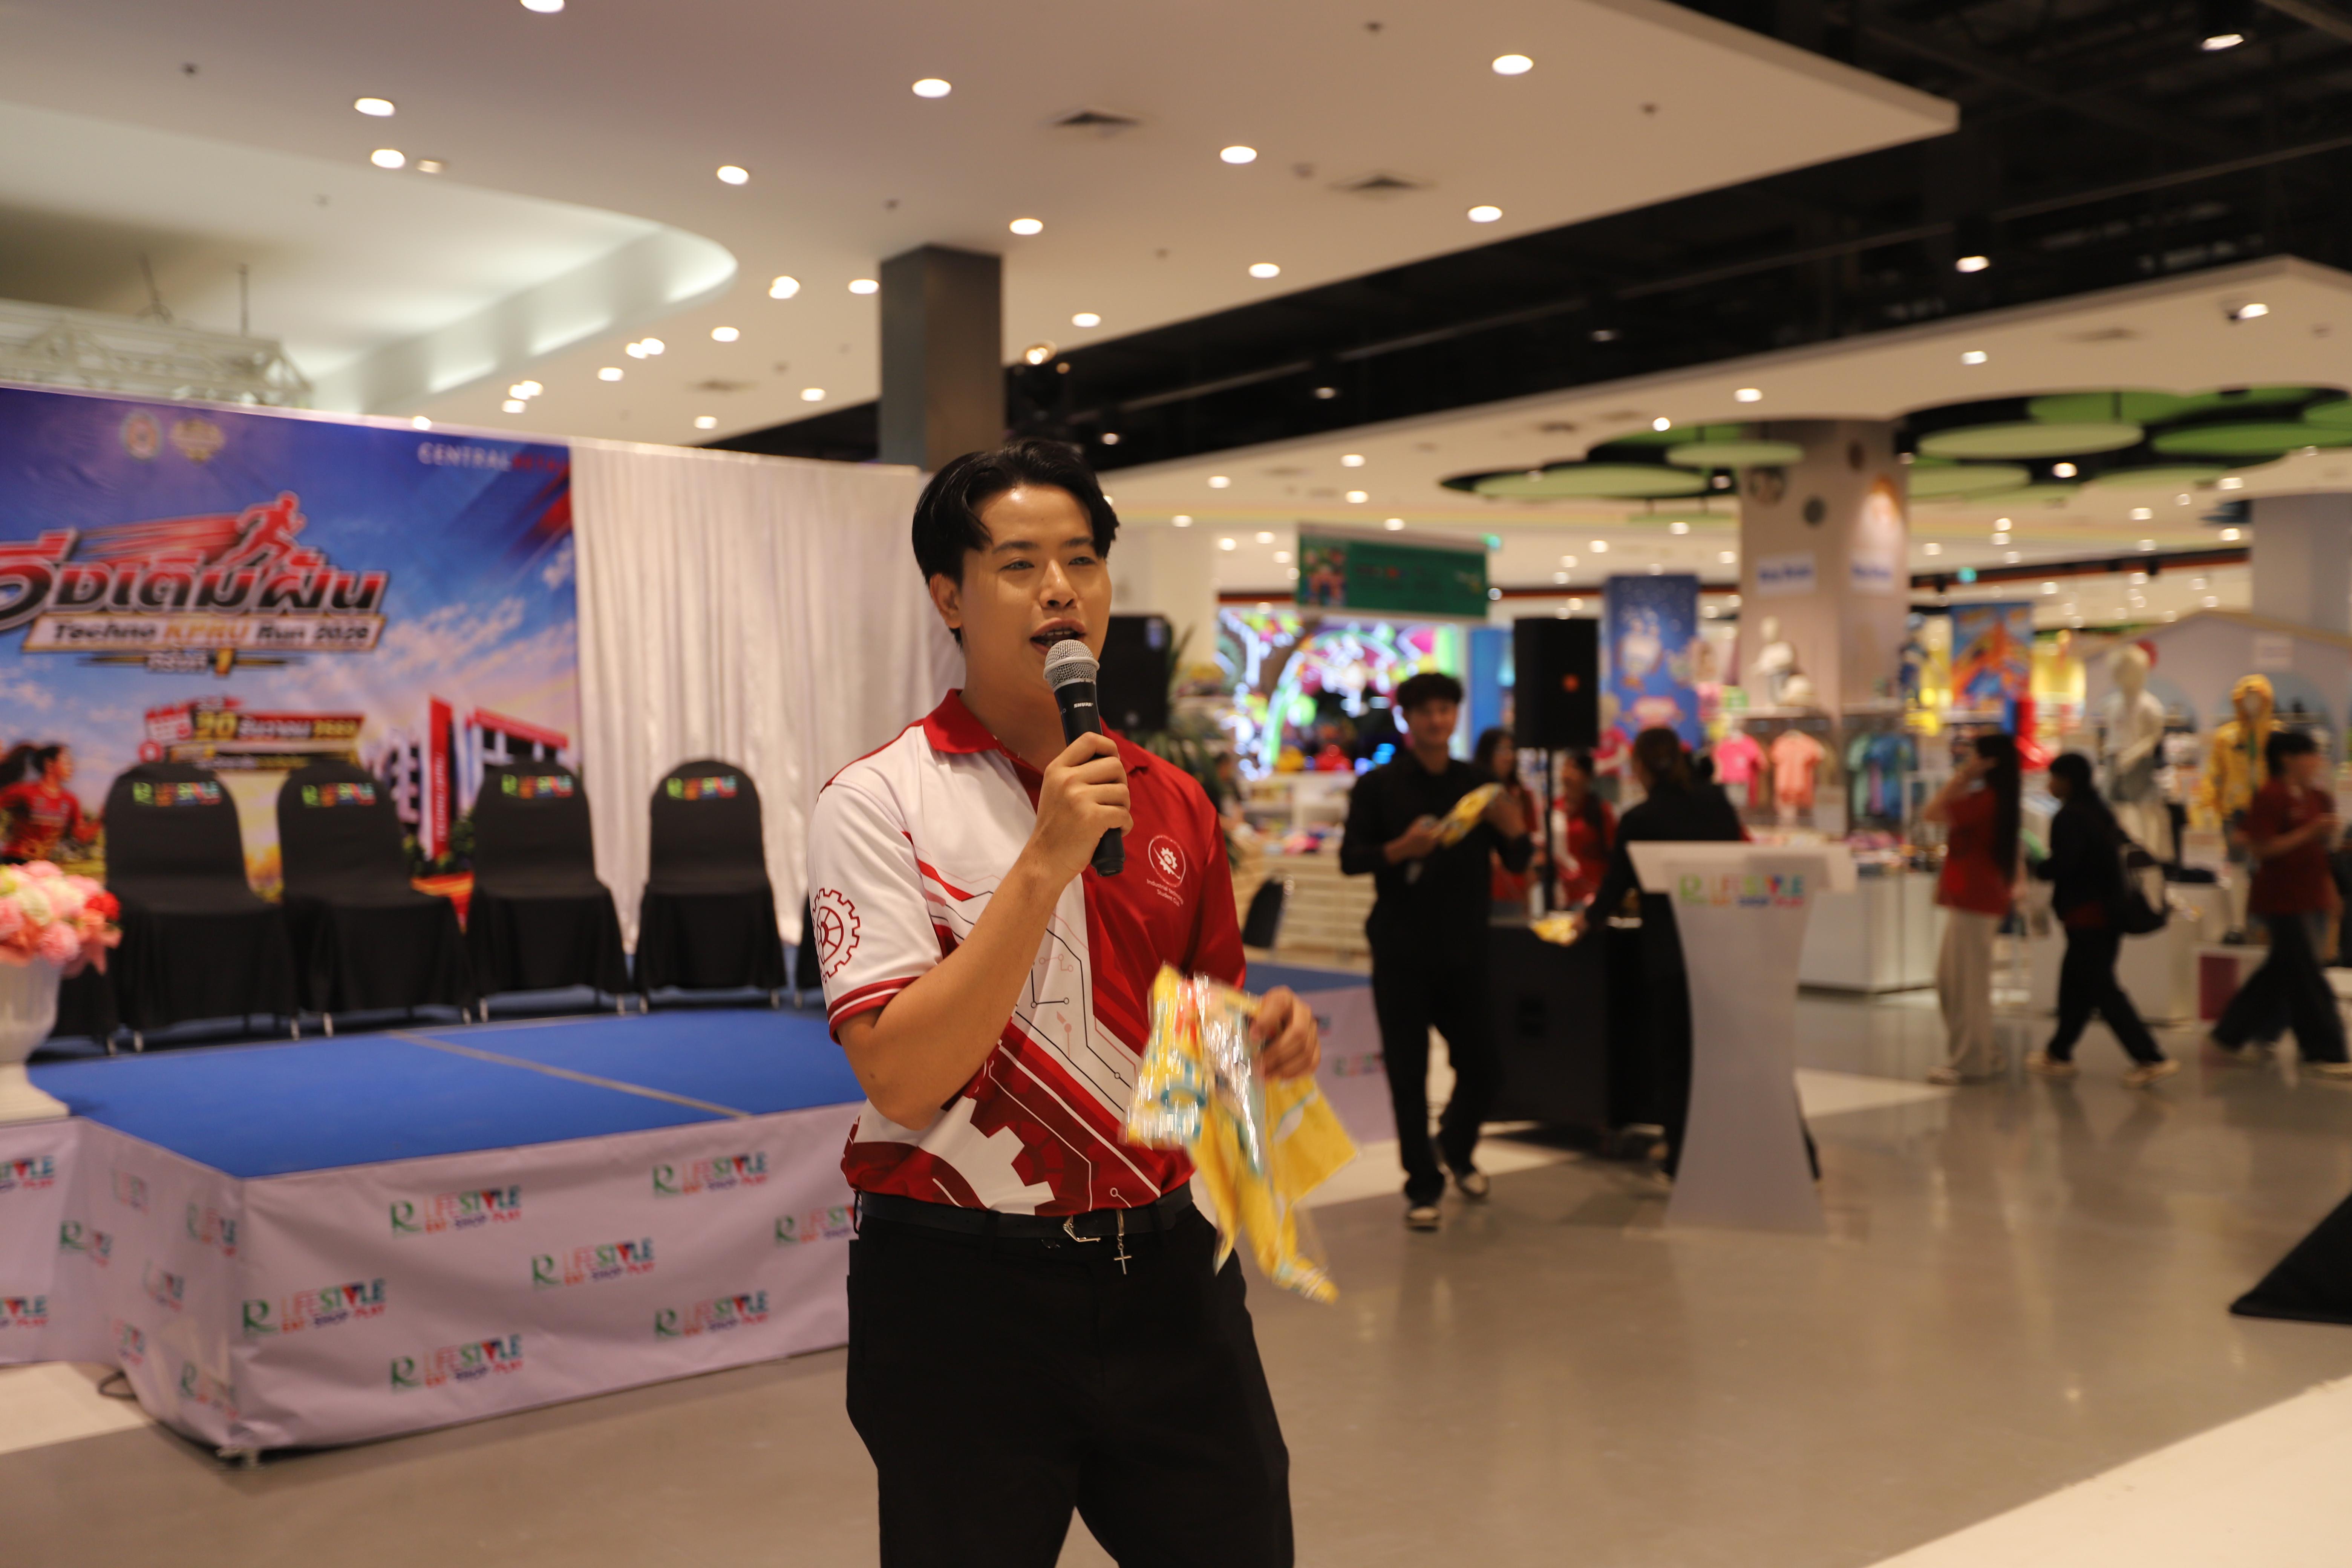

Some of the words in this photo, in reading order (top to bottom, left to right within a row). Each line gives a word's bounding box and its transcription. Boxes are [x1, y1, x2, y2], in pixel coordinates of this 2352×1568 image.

[418, 442, 510, 471] CENTRAL
[54, 623, 156, 640] Techno
[257, 625, 305, 639] Run
[1147, 879, 1168, 891] Industrial
[1157, 889, 1173, 901] Student
